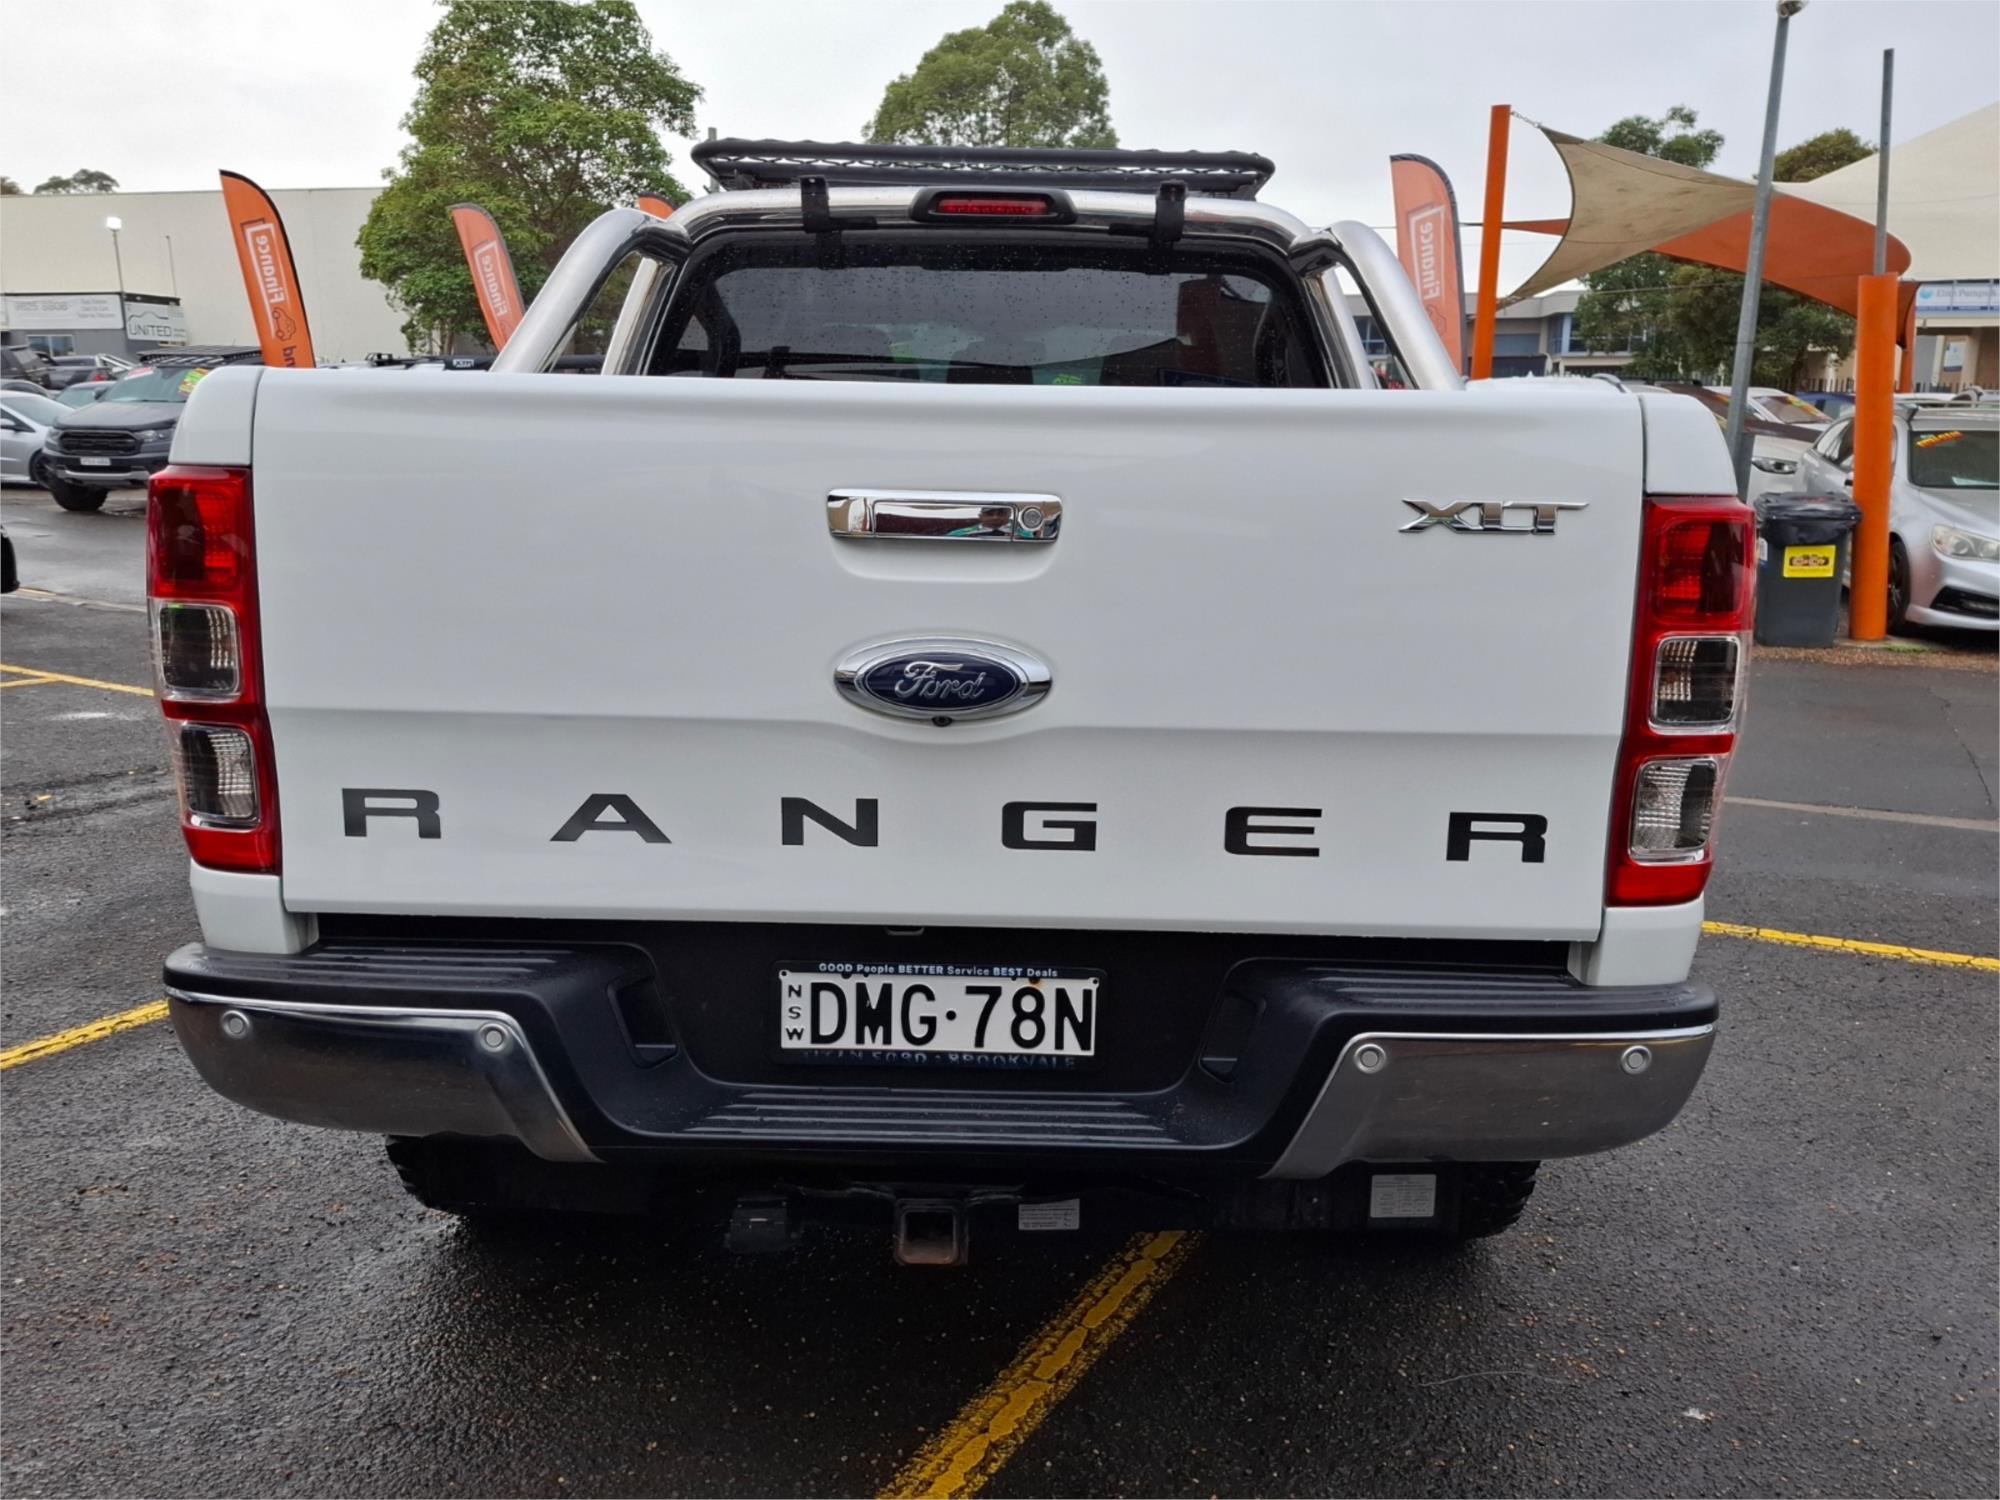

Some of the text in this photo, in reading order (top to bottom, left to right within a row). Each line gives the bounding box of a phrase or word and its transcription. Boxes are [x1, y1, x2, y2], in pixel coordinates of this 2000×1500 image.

[1399, 498, 1590, 535] XLT
[894, 660, 987, 699] Ford
[342, 788, 1548, 863] RANGER
[818, 963, 1058, 978] GOOD People BETTER Service BEST Deals
